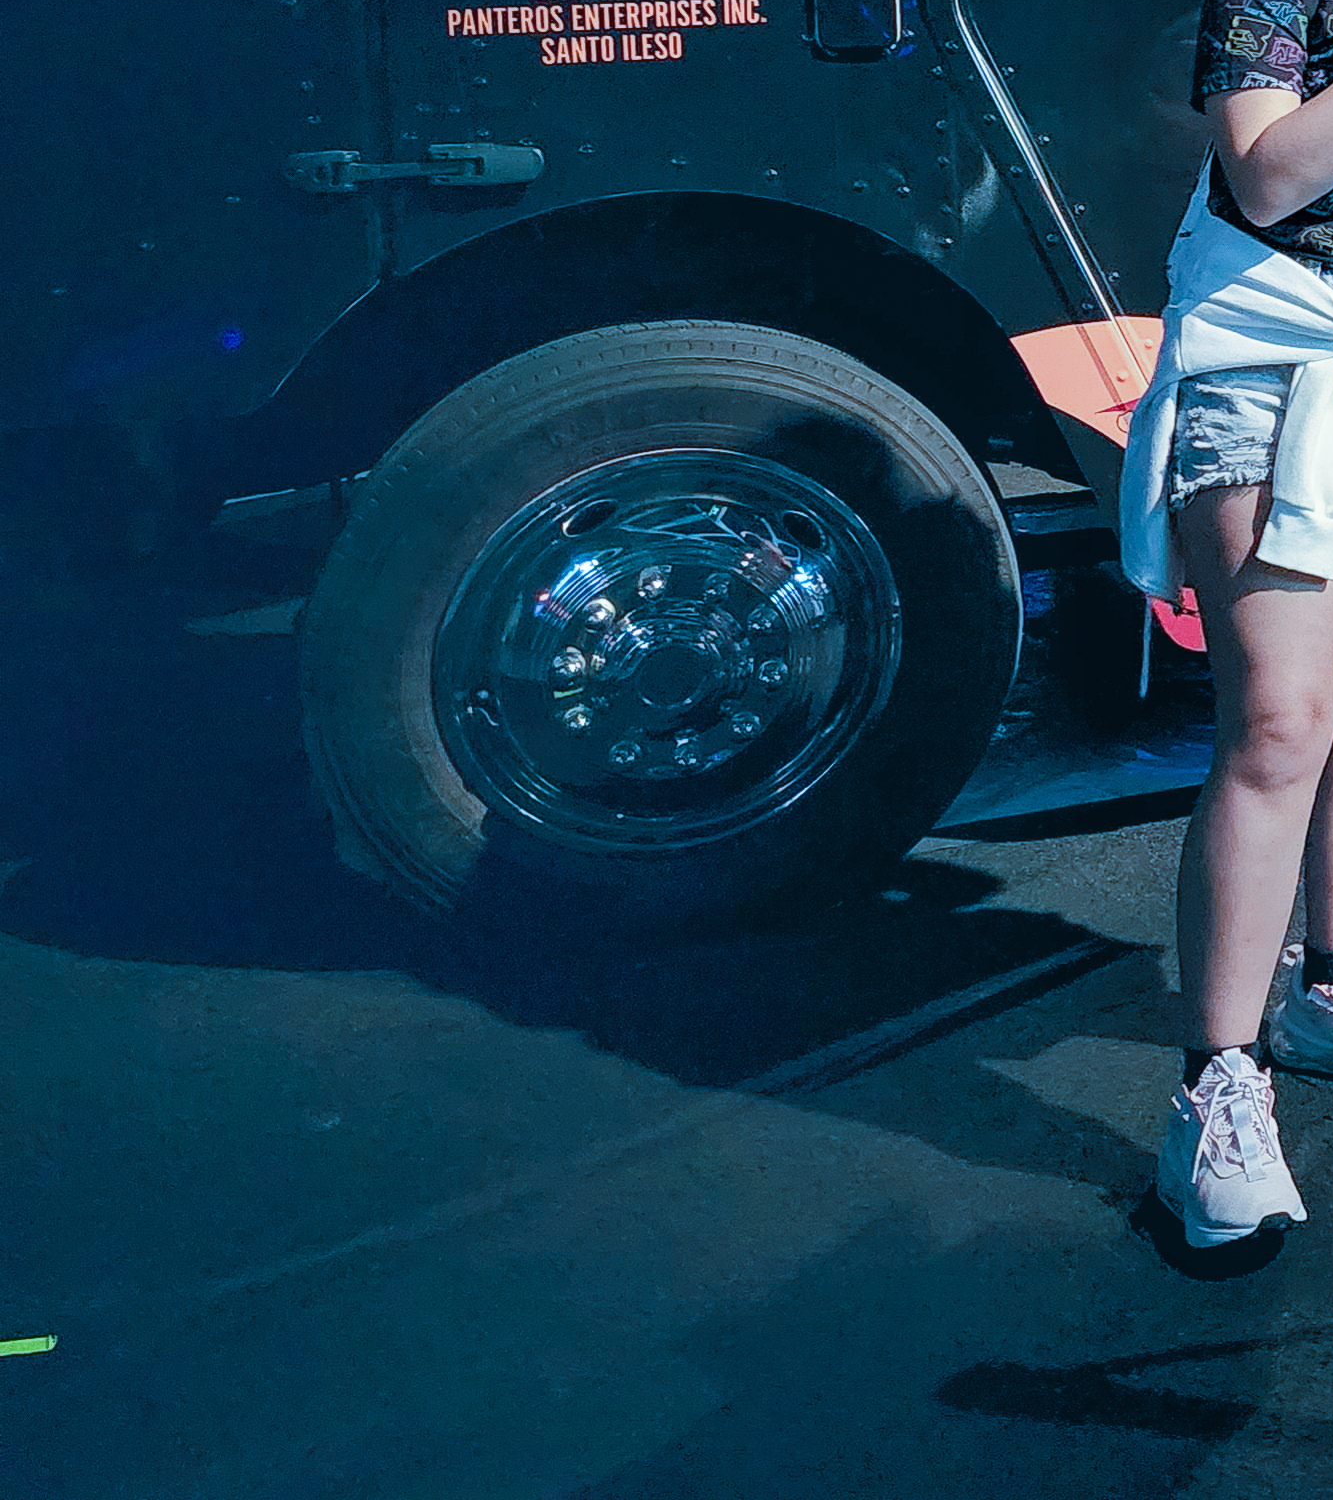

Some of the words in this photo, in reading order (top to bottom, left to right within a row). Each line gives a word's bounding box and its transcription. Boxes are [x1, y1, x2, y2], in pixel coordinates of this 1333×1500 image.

[447, 6, 564, 37] PANTEROS
[572, 0, 717, 33] ENTERPRISES
[541, 34, 615, 65] SANTO
[622, 31, 683, 62] ILESO
